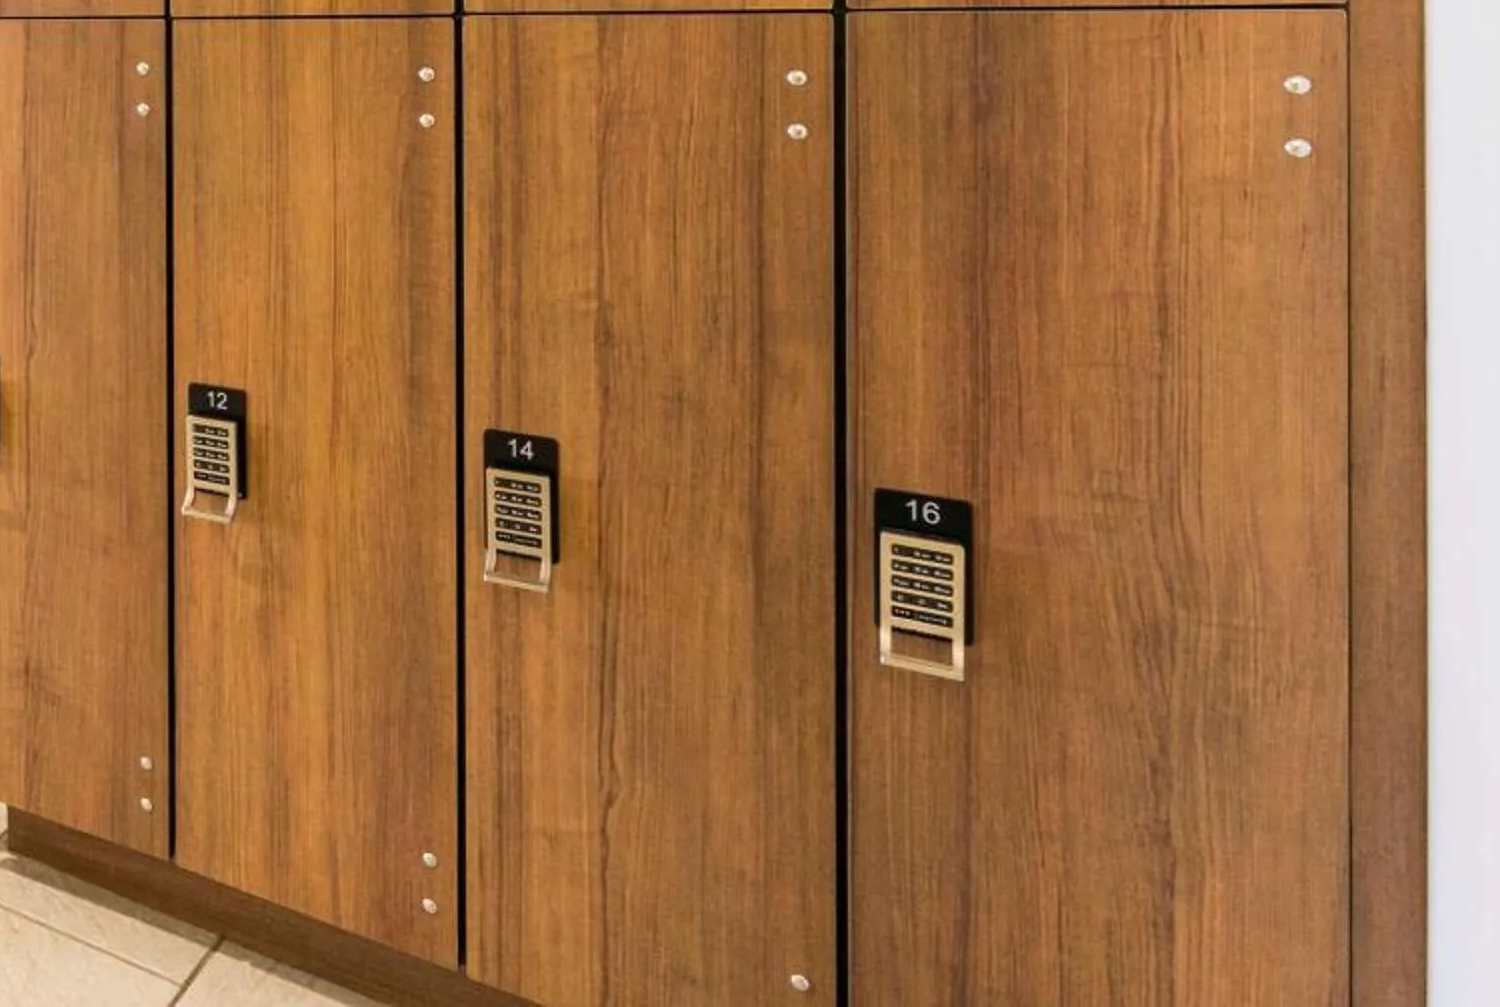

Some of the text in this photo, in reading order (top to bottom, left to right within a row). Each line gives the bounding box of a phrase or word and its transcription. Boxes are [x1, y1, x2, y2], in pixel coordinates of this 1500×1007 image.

[207, 390, 228, 410] 12
[507, 438, 534, 461] 14
[905, 499, 941, 525] 16
